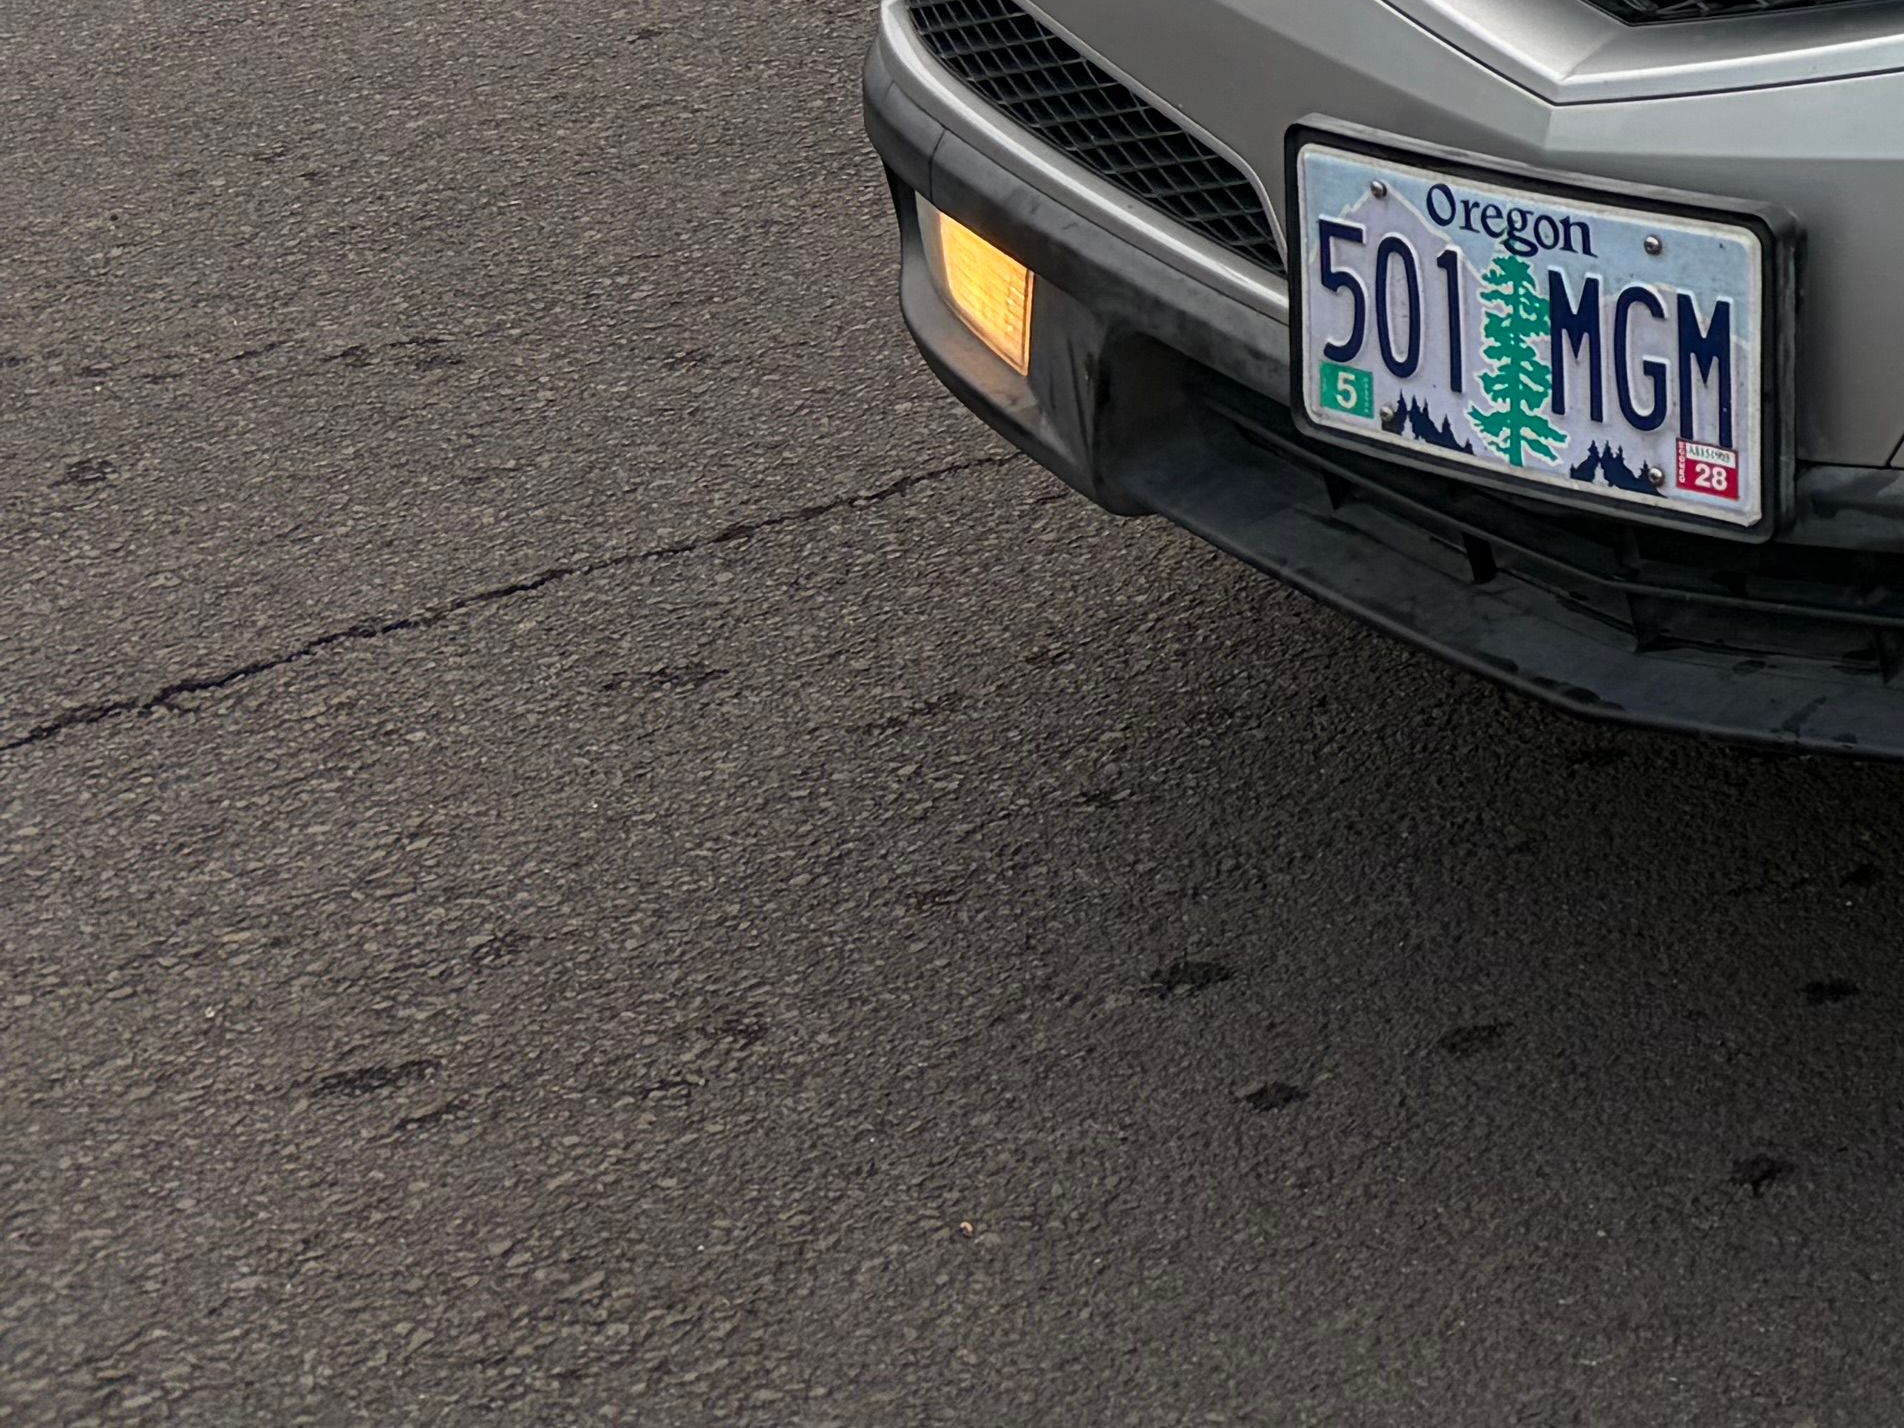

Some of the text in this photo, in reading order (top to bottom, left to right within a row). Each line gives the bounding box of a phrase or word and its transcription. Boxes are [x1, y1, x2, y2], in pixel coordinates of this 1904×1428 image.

[1425, 183, 1598, 260] Oregon
[1317, 215, 1734, 448] 501 MGM
[1336, 371, 1358, 410] 5
[1694, 462, 1729, 492] 28
